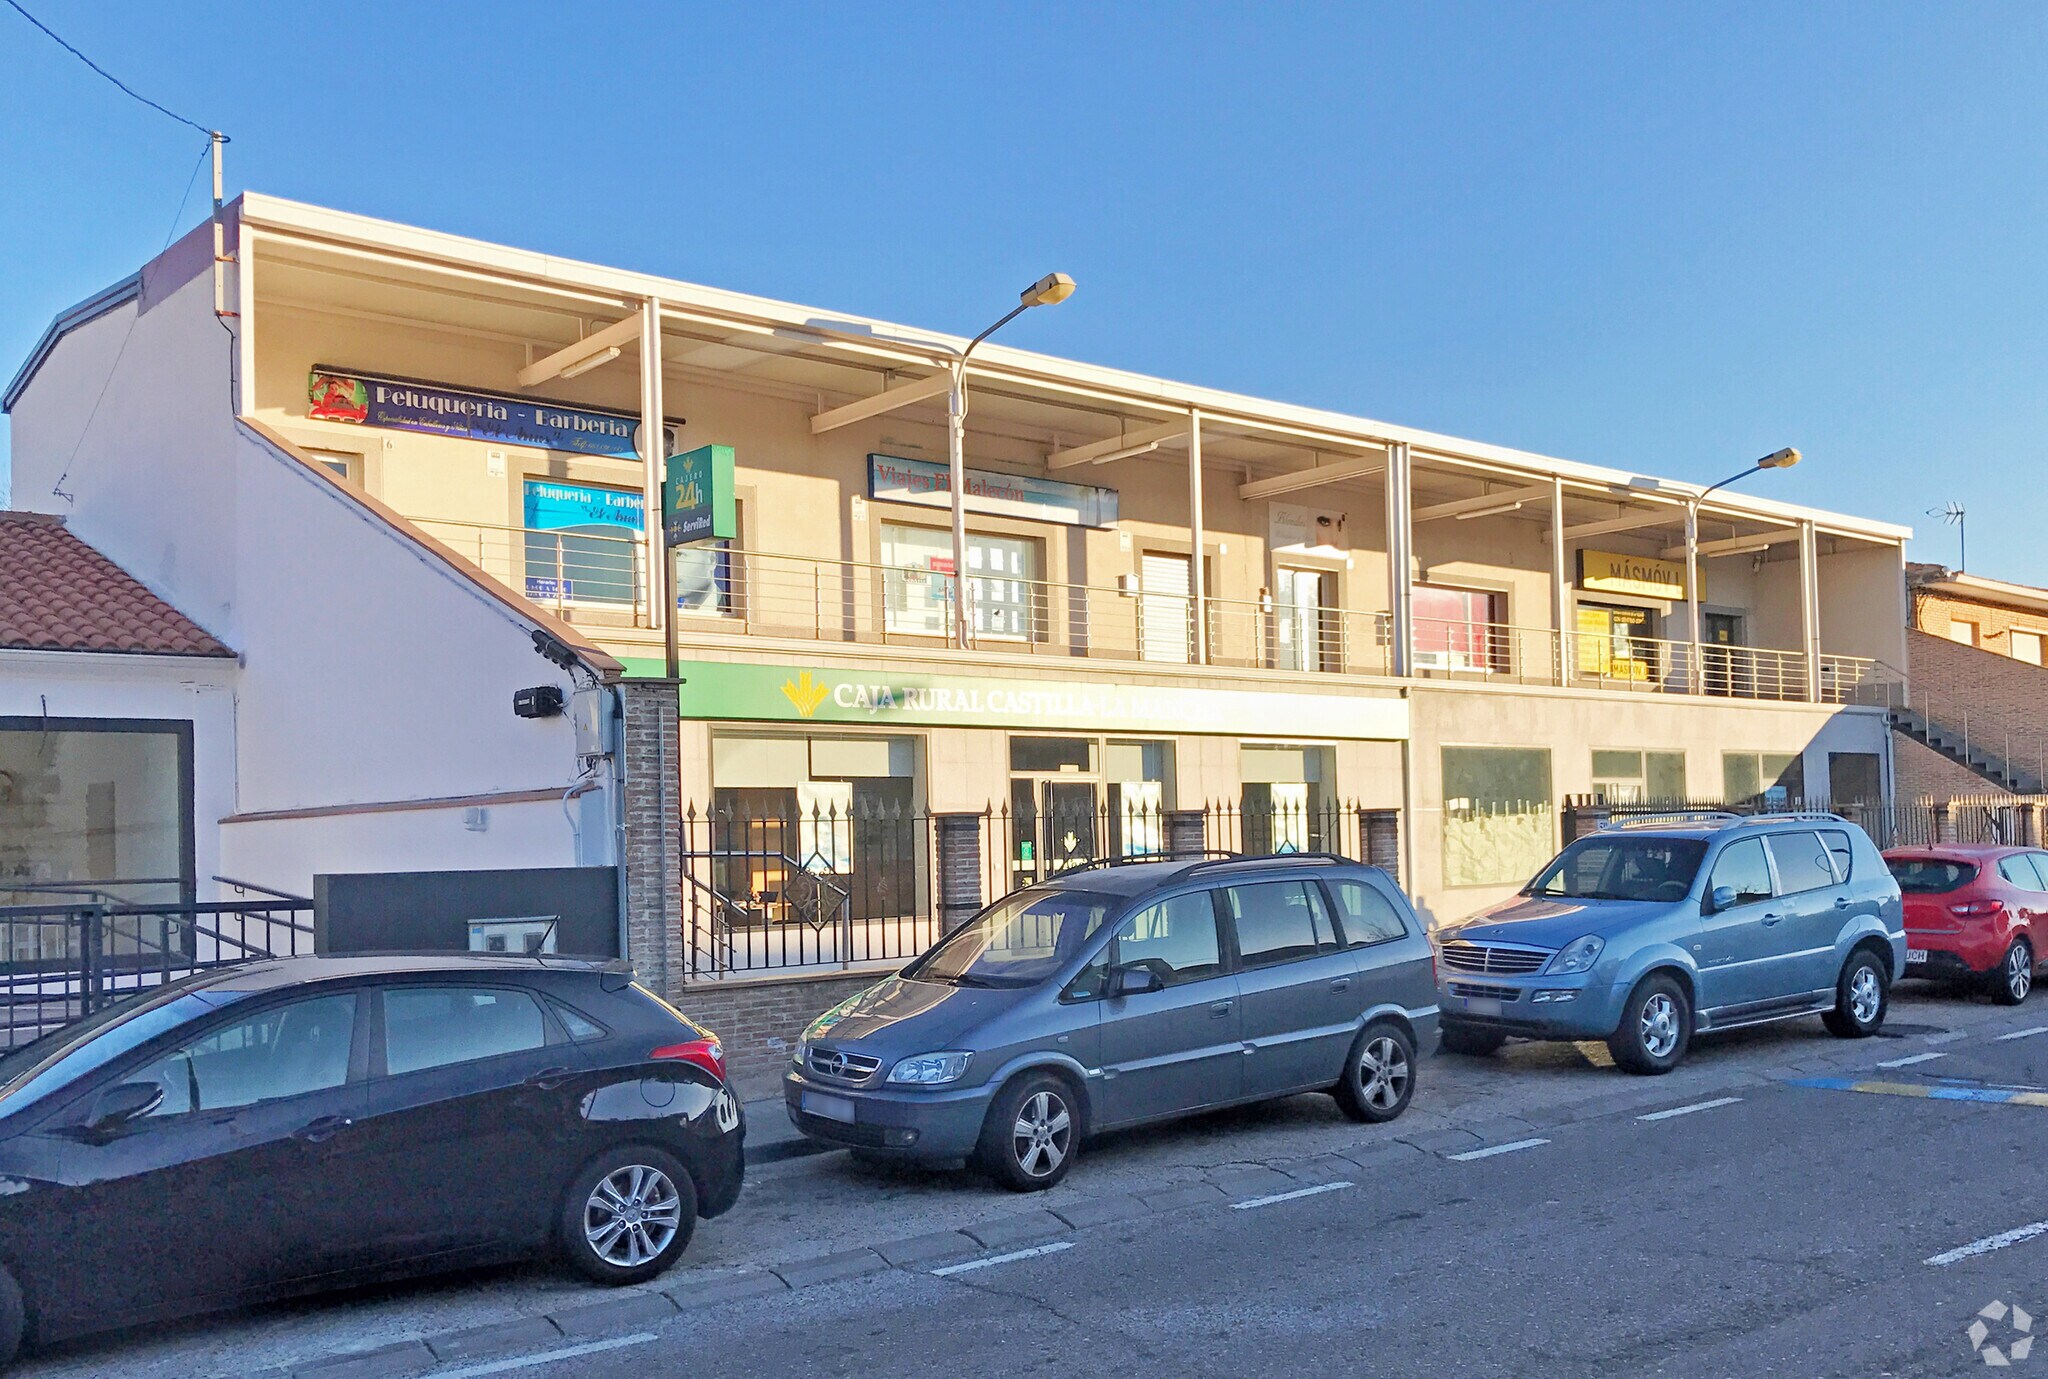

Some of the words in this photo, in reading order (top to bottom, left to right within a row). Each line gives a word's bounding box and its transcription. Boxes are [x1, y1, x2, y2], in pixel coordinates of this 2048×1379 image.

[386, 440, 393, 450] 6
[675, 470, 703, 485] CAJERO
[877, 464, 930, 492] Viajes
[934, 472, 951, 493] El
[675, 480, 704, 510] 24h
[682, 514, 711, 533] ServiRed
[834, 683, 898, 715] CAJA
[902, 687, 984, 713] RURAL
